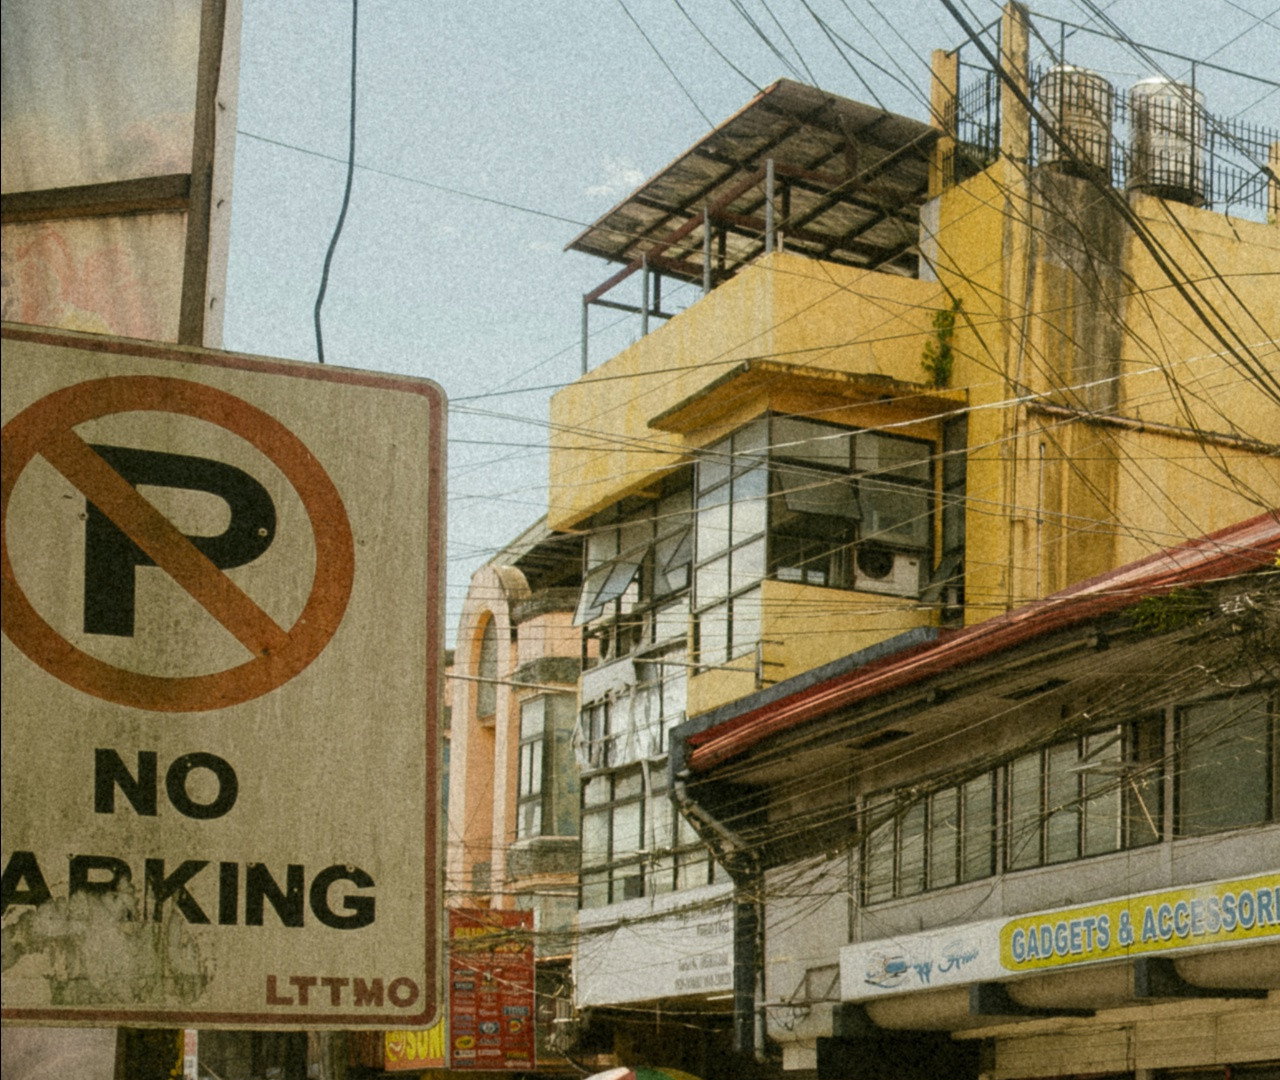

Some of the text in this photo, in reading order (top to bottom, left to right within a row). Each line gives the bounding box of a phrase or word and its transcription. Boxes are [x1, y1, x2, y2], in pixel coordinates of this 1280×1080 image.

[93, 747, 240, 820] NO
[1012, 914, 1111, 963] GADGETS
[1118, 909, 1134, 947] &
[266, 974, 420, 1009] LTTMO
